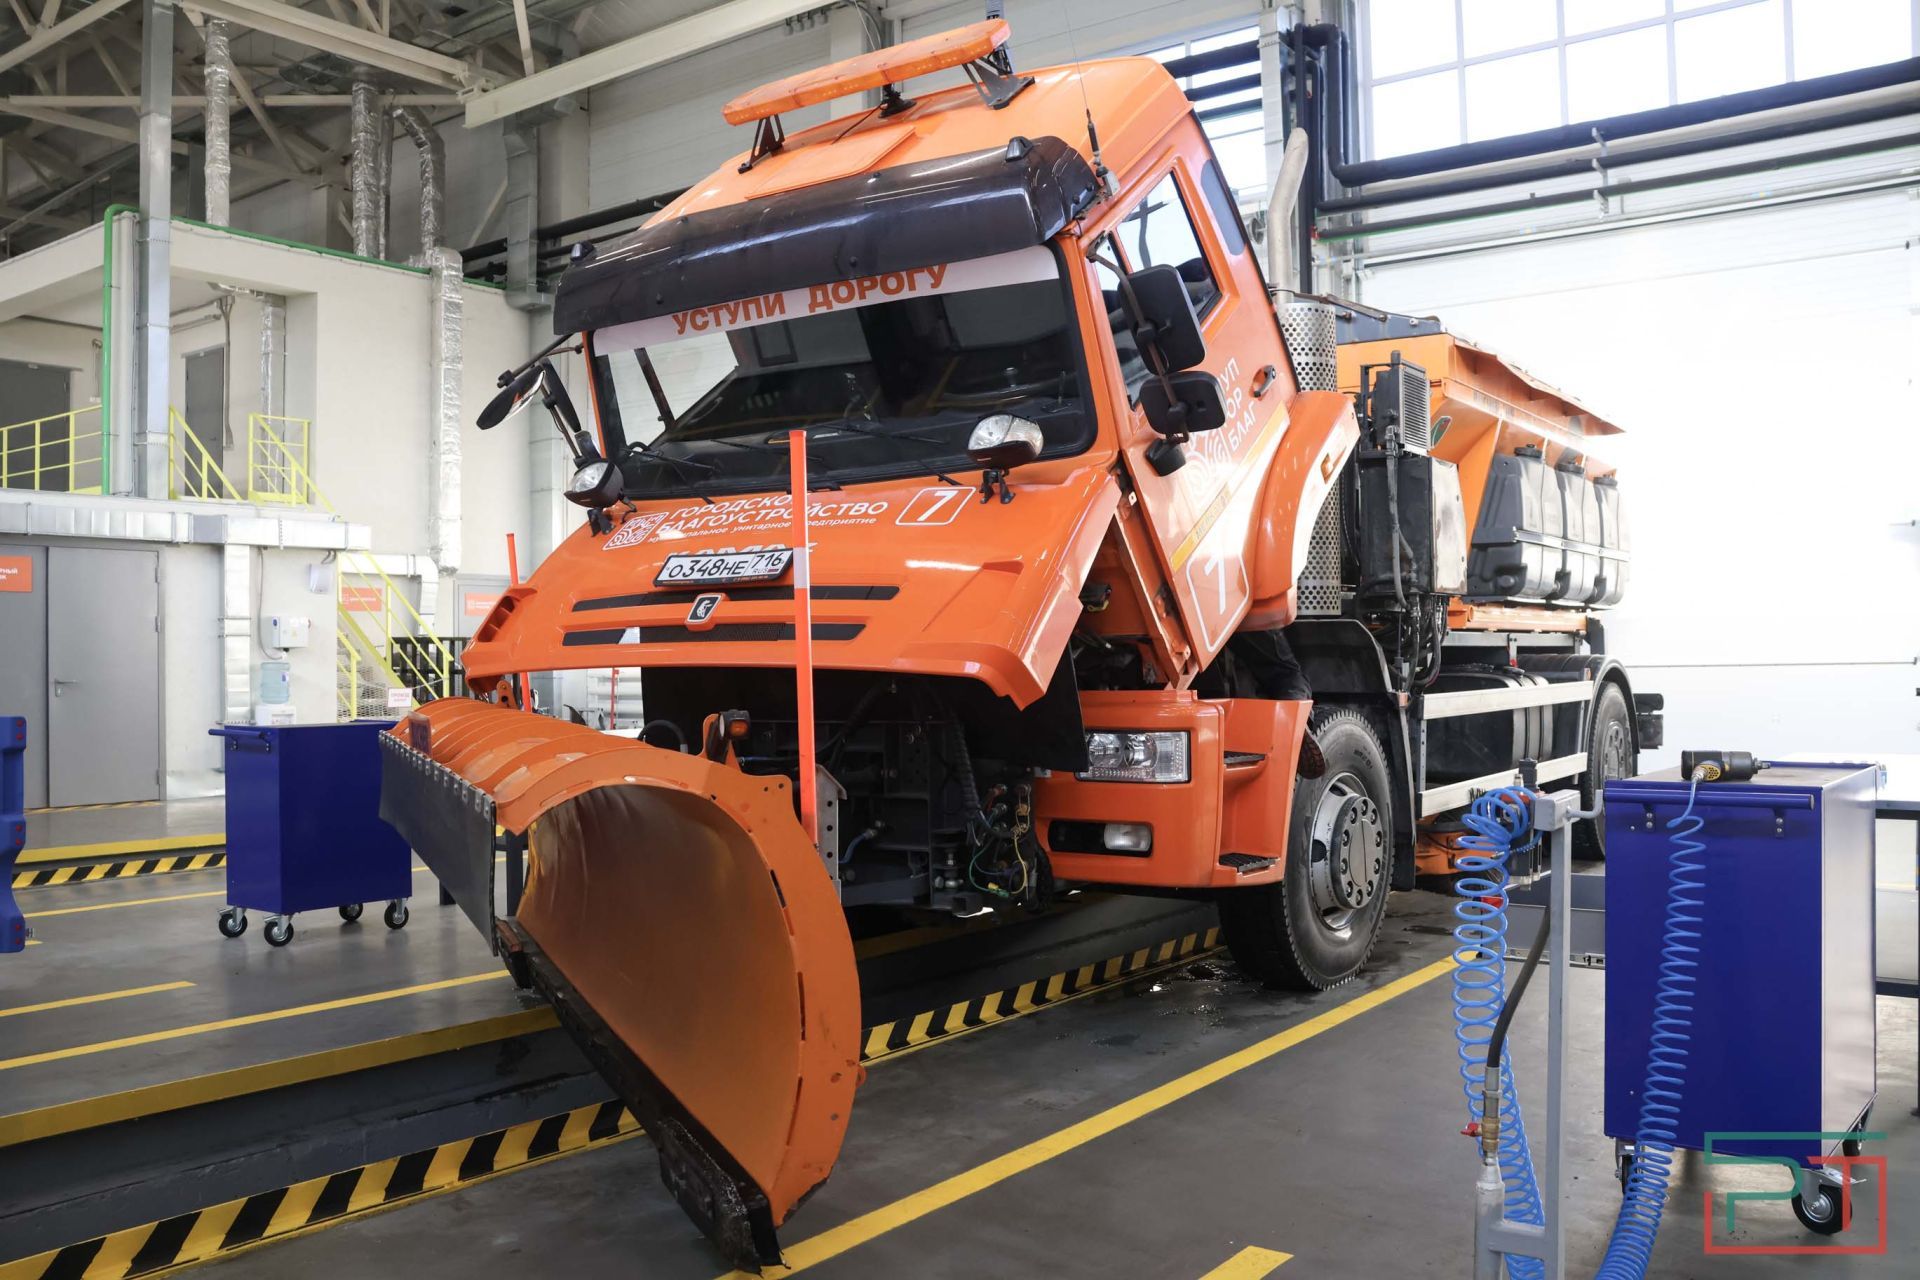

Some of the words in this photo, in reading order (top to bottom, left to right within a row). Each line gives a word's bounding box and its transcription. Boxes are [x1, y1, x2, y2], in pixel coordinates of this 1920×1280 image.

[672, 293, 787, 335] УСТУПИ
[807, 263, 948, 313] ДОРОГУ
[1216, 357, 1240, 395] УП
[1227, 401, 1257, 452] БЛАГ
[669, 493, 810, 520] ГОРОДСКО
[916, 490, 959, 522] 7
[730, 521, 792, 534] унитарное
[796, 517, 877, 529] едприятие
[668, 558, 749, 578] О348НЕ
[751, 552, 784, 569] 716
